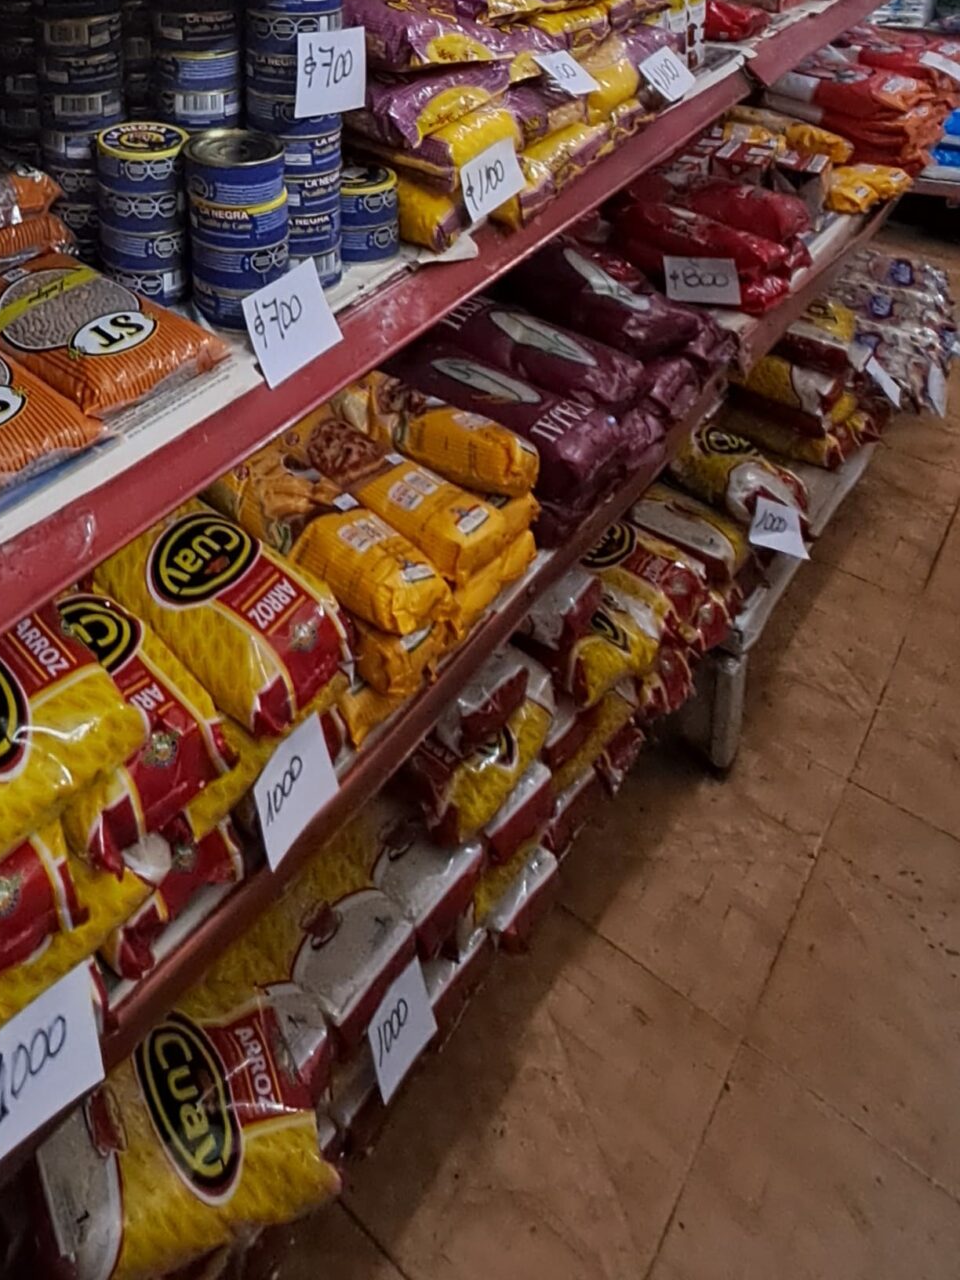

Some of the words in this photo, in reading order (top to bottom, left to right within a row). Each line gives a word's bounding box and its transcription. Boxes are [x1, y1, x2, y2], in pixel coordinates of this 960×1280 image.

[303, 42, 353, 89] $700
[211, 209, 249, 221] NEGRA
[295, 214, 330, 227] NEGRA
[90, 314, 145, 349] ST
[252, 294, 302, 349] $700
[247, 577, 298, 630] ARROZ
[14, 616, 70, 677] ARROZ
[263, 753, 304, 828] 1000
